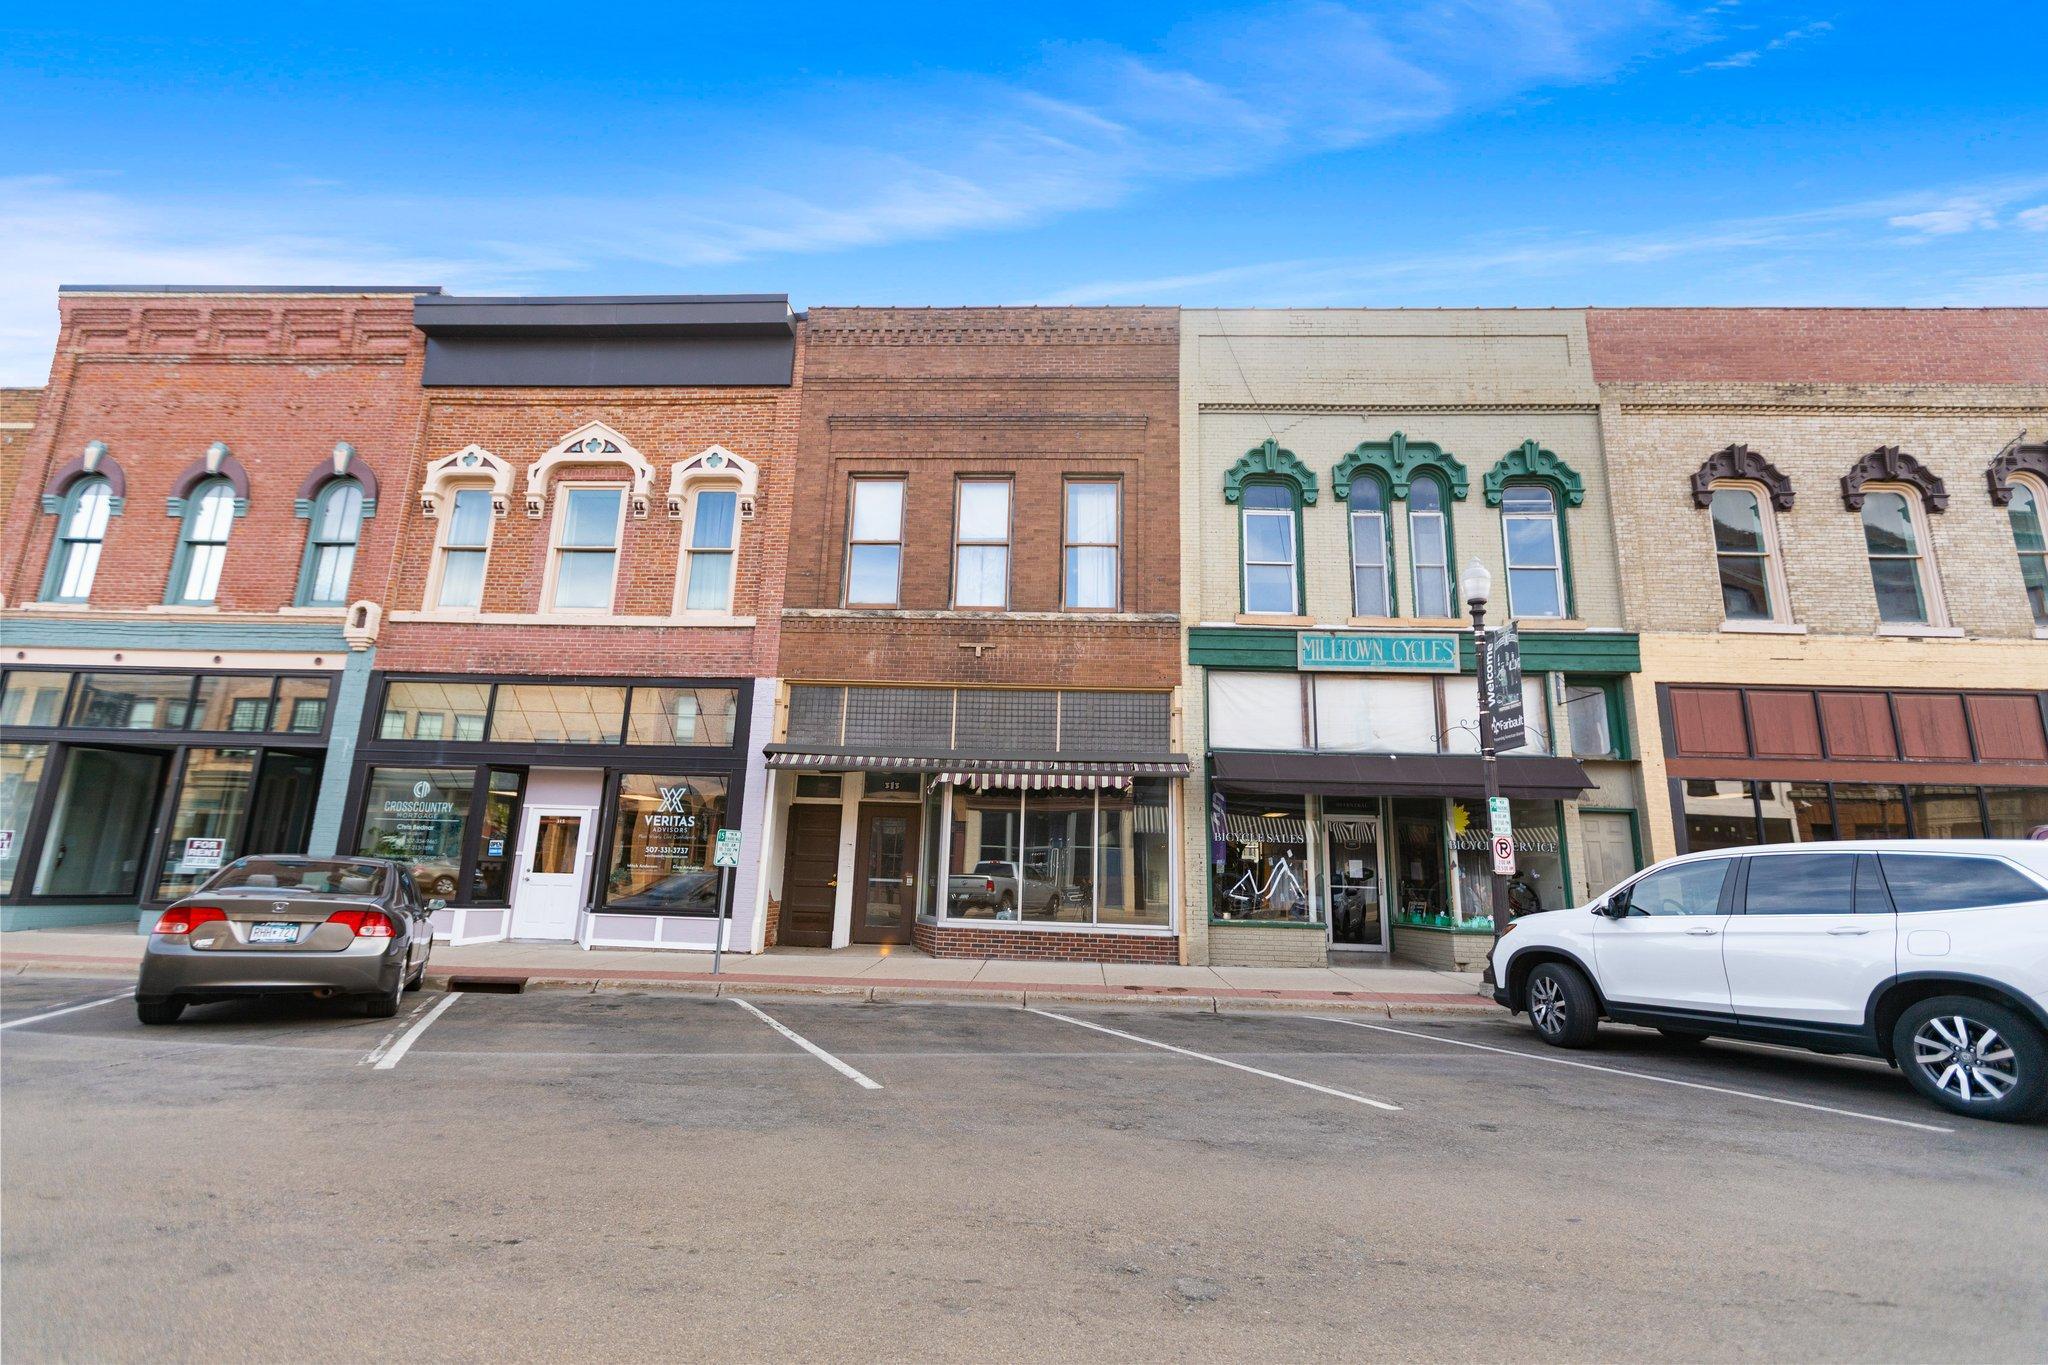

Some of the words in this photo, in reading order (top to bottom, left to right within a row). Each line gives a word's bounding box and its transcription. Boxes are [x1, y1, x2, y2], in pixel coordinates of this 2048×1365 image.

[1303, 639, 1383, 661] MILLTOWN
[1392, 639, 1455, 662] CYCLES
[1486, 643, 1495, 707] Welcome
[1500, 715, 1524, 731] Faribault
[384, 801, 454, 813] CROSSCOUNTRY
[396, 823, 412, 831] Chris
[645, 815, 695, 827] VERITAS
[192, 840, 216, 849] FOR
[1214, 833, 1265, 843] BICYCLE
[1267, 834, 1304, 844] SALES
[189, 848, 221, 857] RENT
[645, 846, 689, 854] 507-331-3737
[1513, 841, 1559, 853] ERVICE
